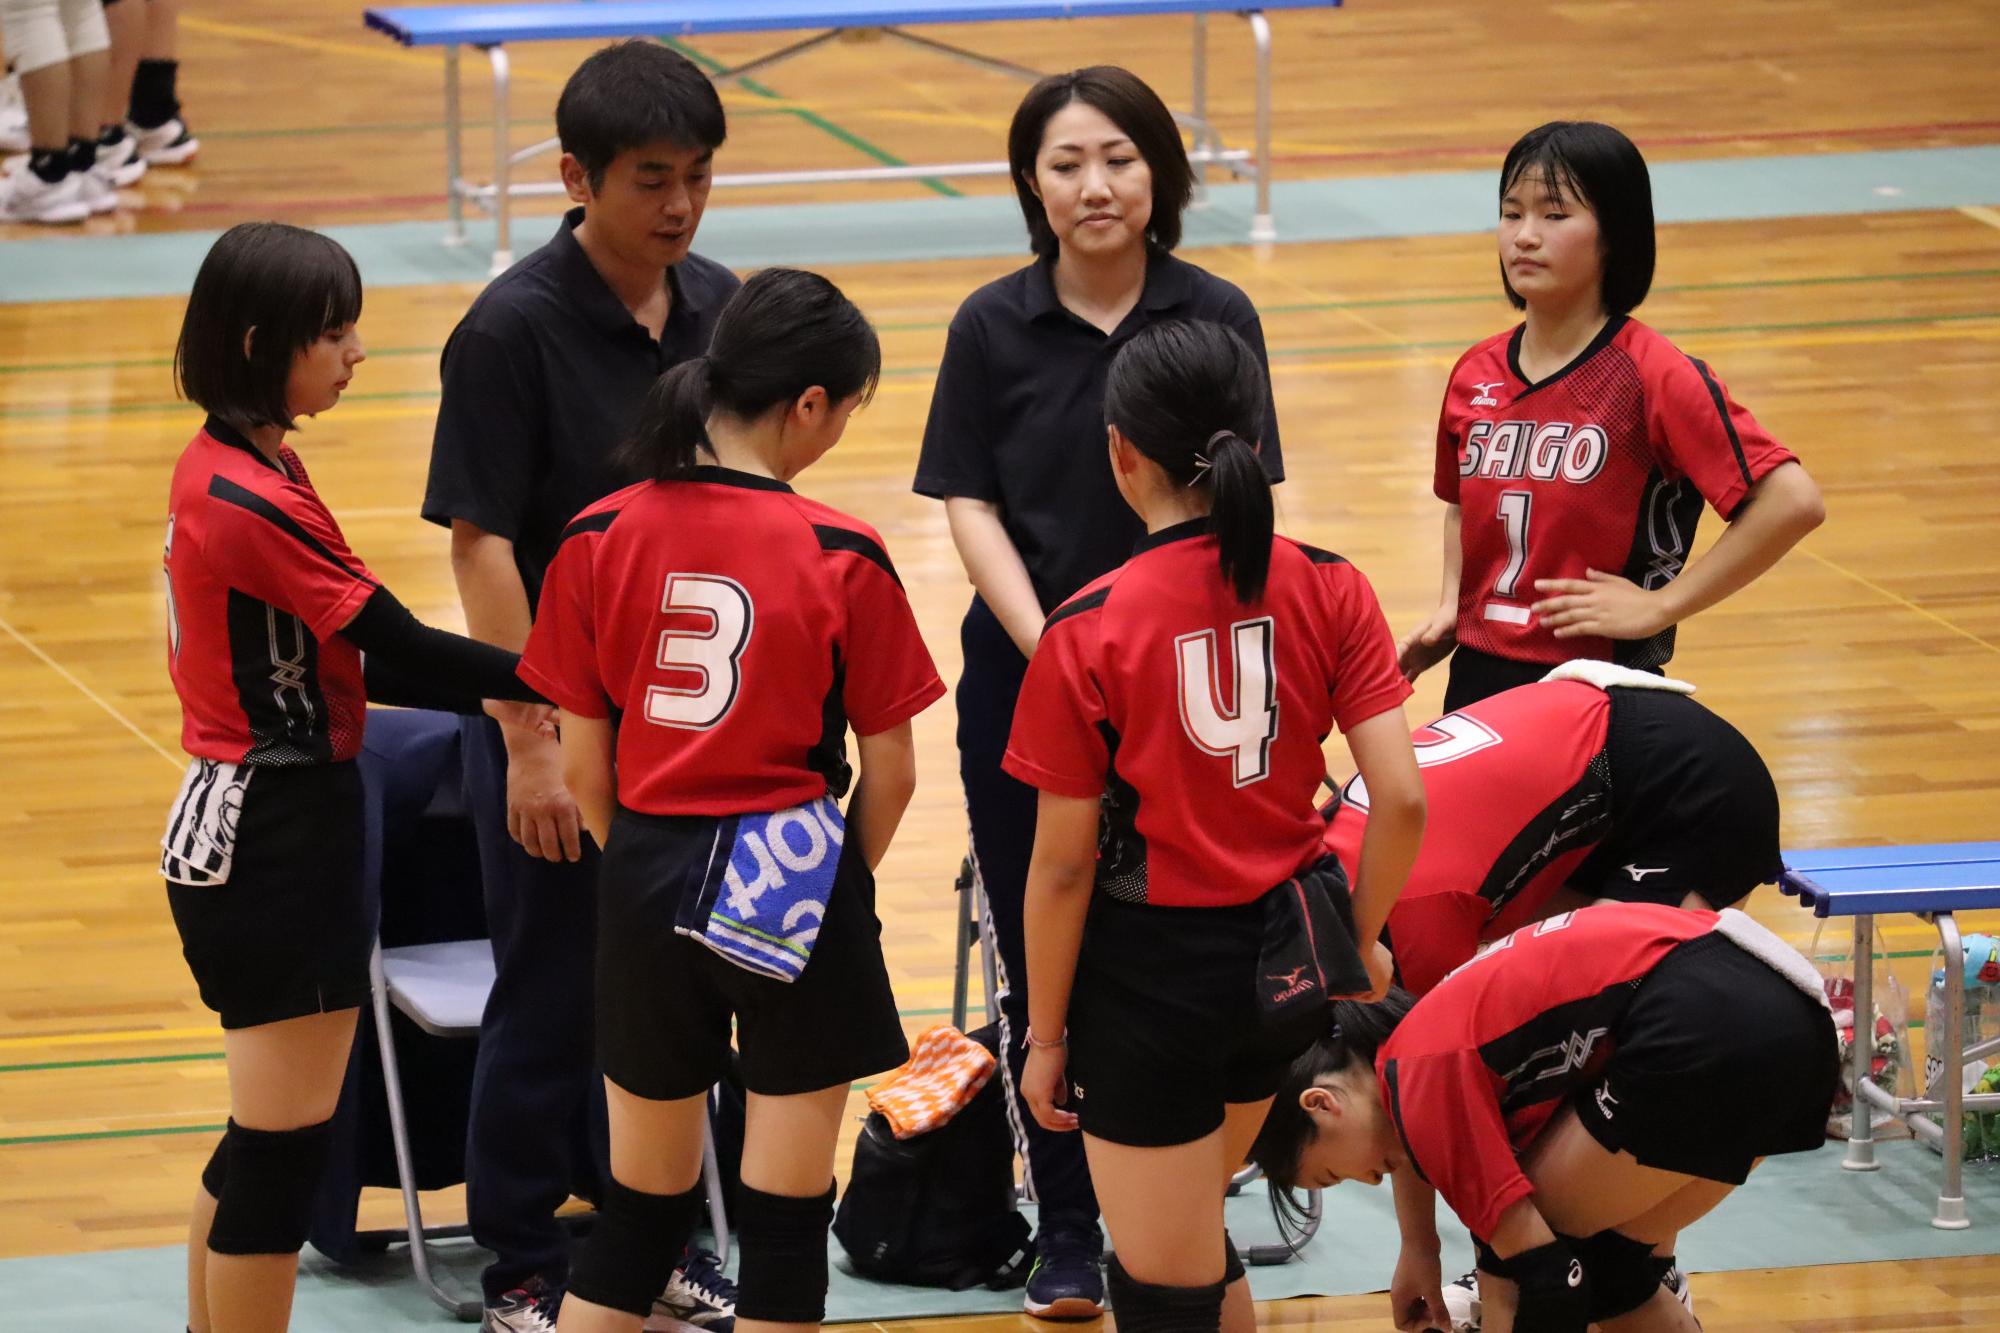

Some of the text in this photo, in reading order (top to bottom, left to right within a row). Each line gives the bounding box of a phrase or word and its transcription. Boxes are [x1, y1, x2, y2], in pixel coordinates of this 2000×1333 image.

[1460, 421, 1609, 484] SAIGO
[1494, 490, 1533, 597] 1
[643, 572, 755, 731] 3
[1174, 615, 1278, 788] 4
